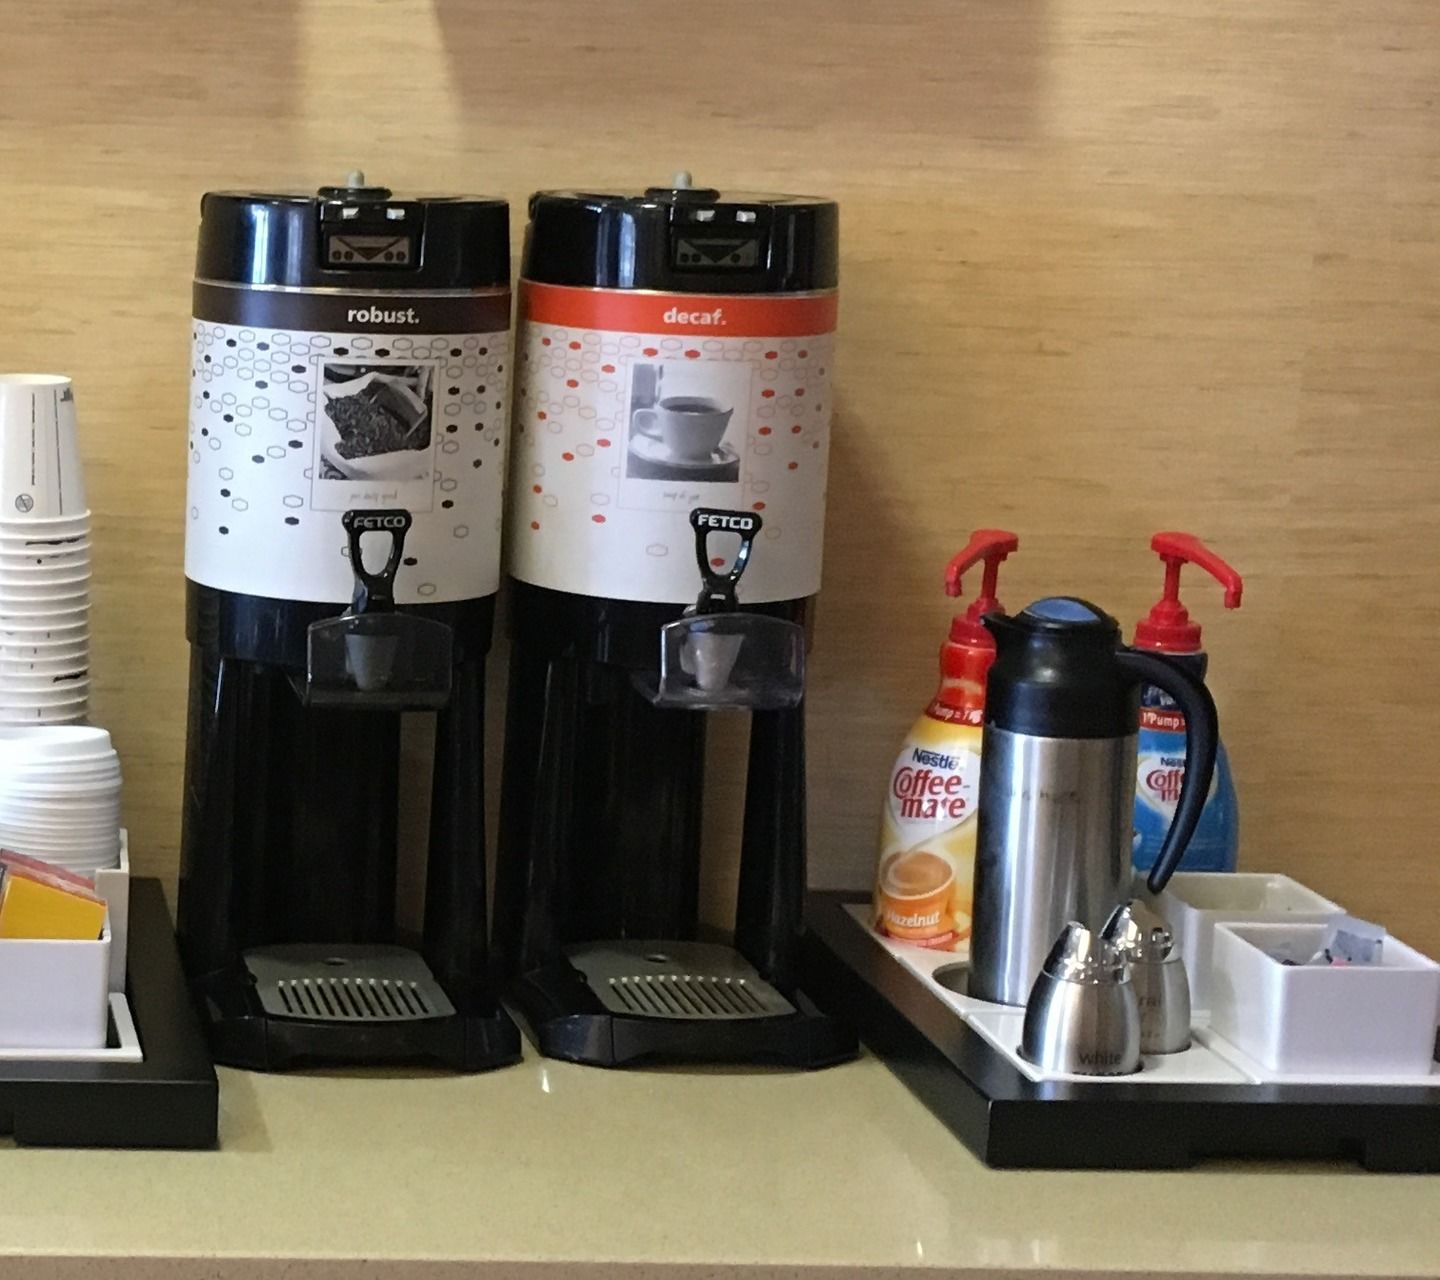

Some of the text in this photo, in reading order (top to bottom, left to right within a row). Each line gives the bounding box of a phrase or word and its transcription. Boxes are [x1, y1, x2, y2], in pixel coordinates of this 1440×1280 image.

[347, 306, 420, 324] robust.
[663, 307, 727, 326] decaf.
[353, 516, 406, 529] FETCO
[697, 514, 753, 530] FETCO
[1149, 712, 1179, 730] Pump
[1146, 769, 1185, 791] Coff
[901, 797, 966, 819] mate
